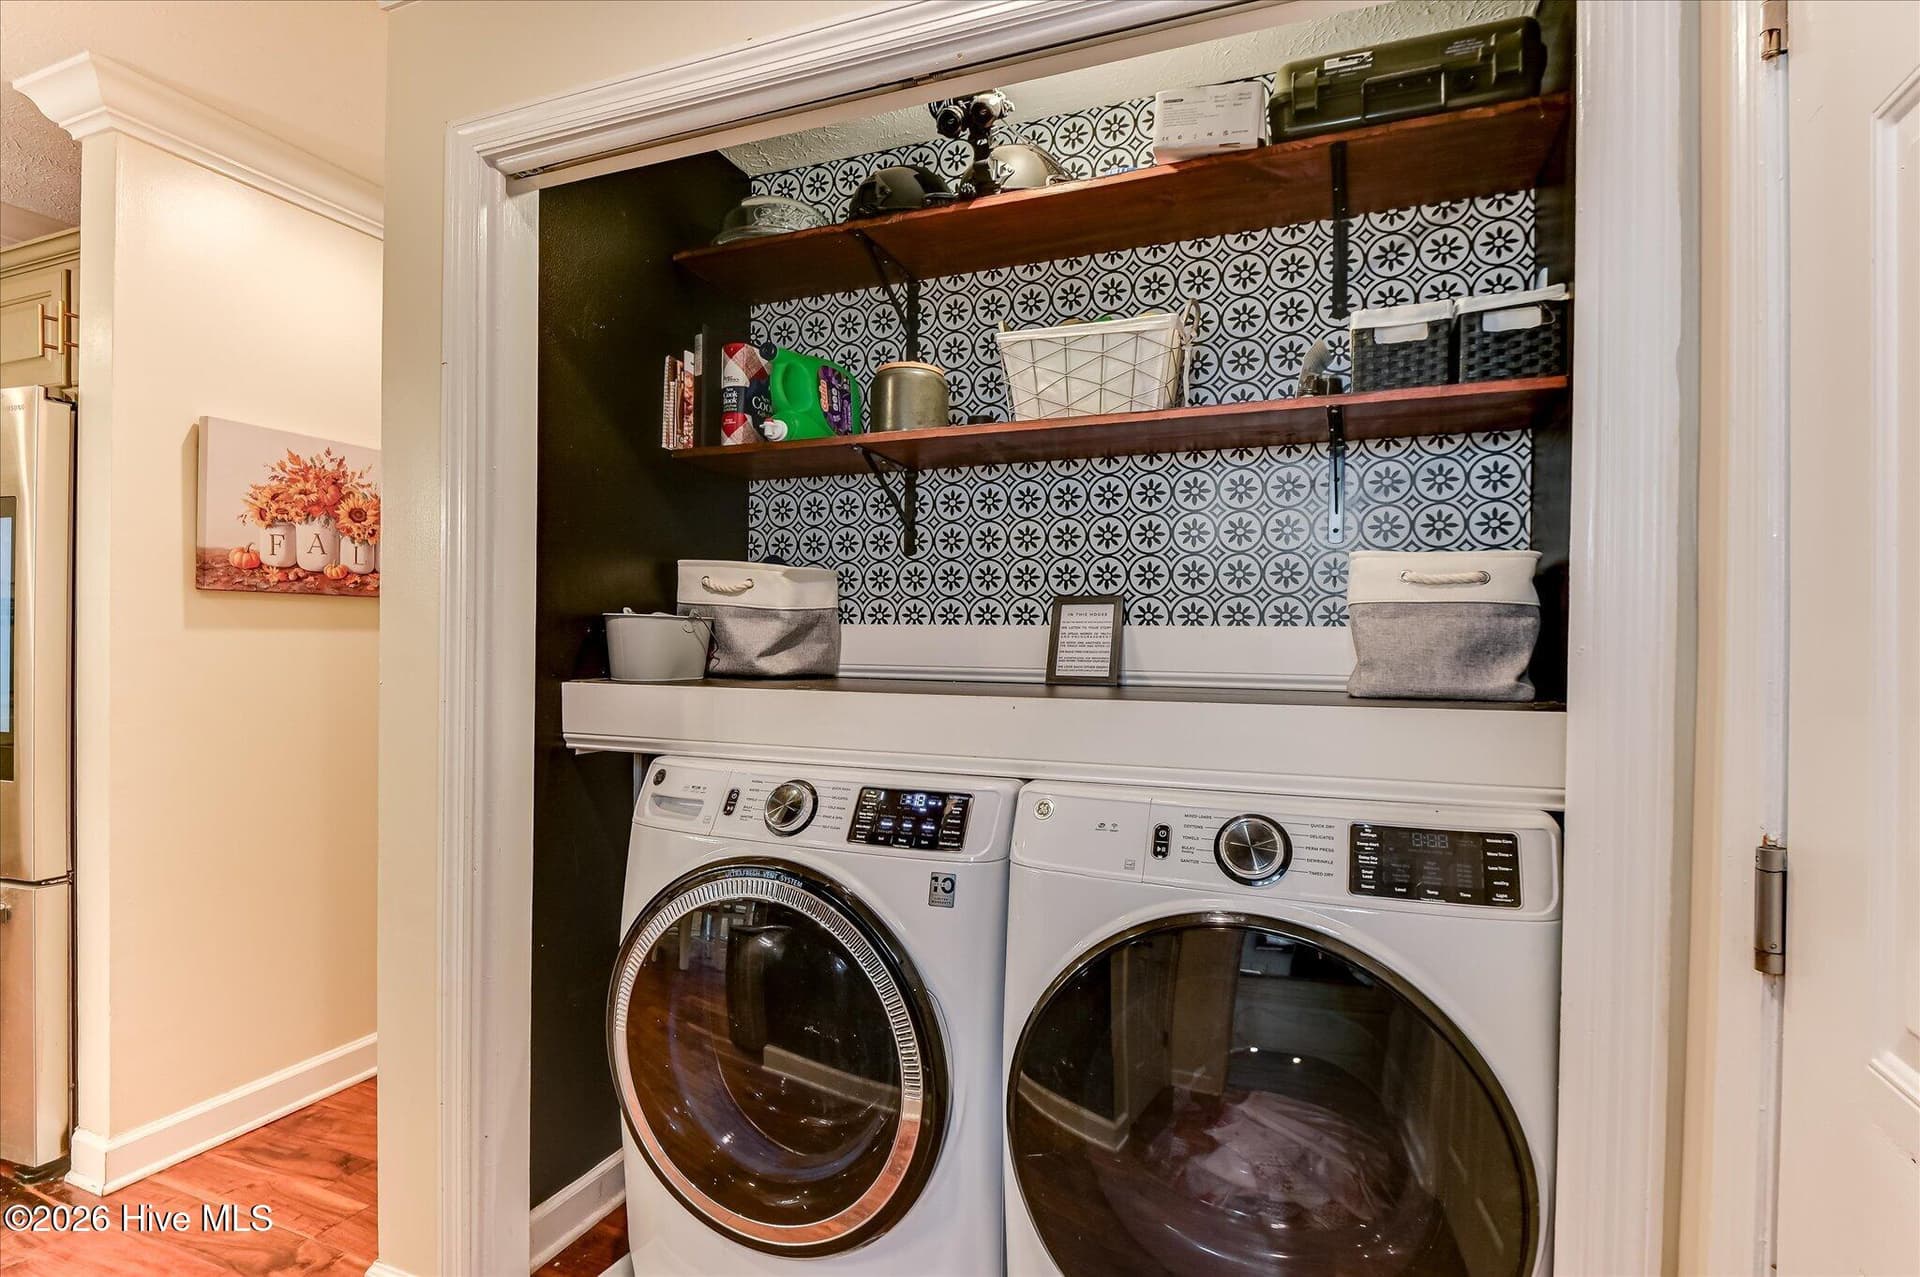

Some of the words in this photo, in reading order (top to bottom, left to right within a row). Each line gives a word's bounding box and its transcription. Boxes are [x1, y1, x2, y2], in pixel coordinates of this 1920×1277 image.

[269, 534, 285, 556] F
[307, 533, 328, 556] A
[353, 546, 366, 566] L
